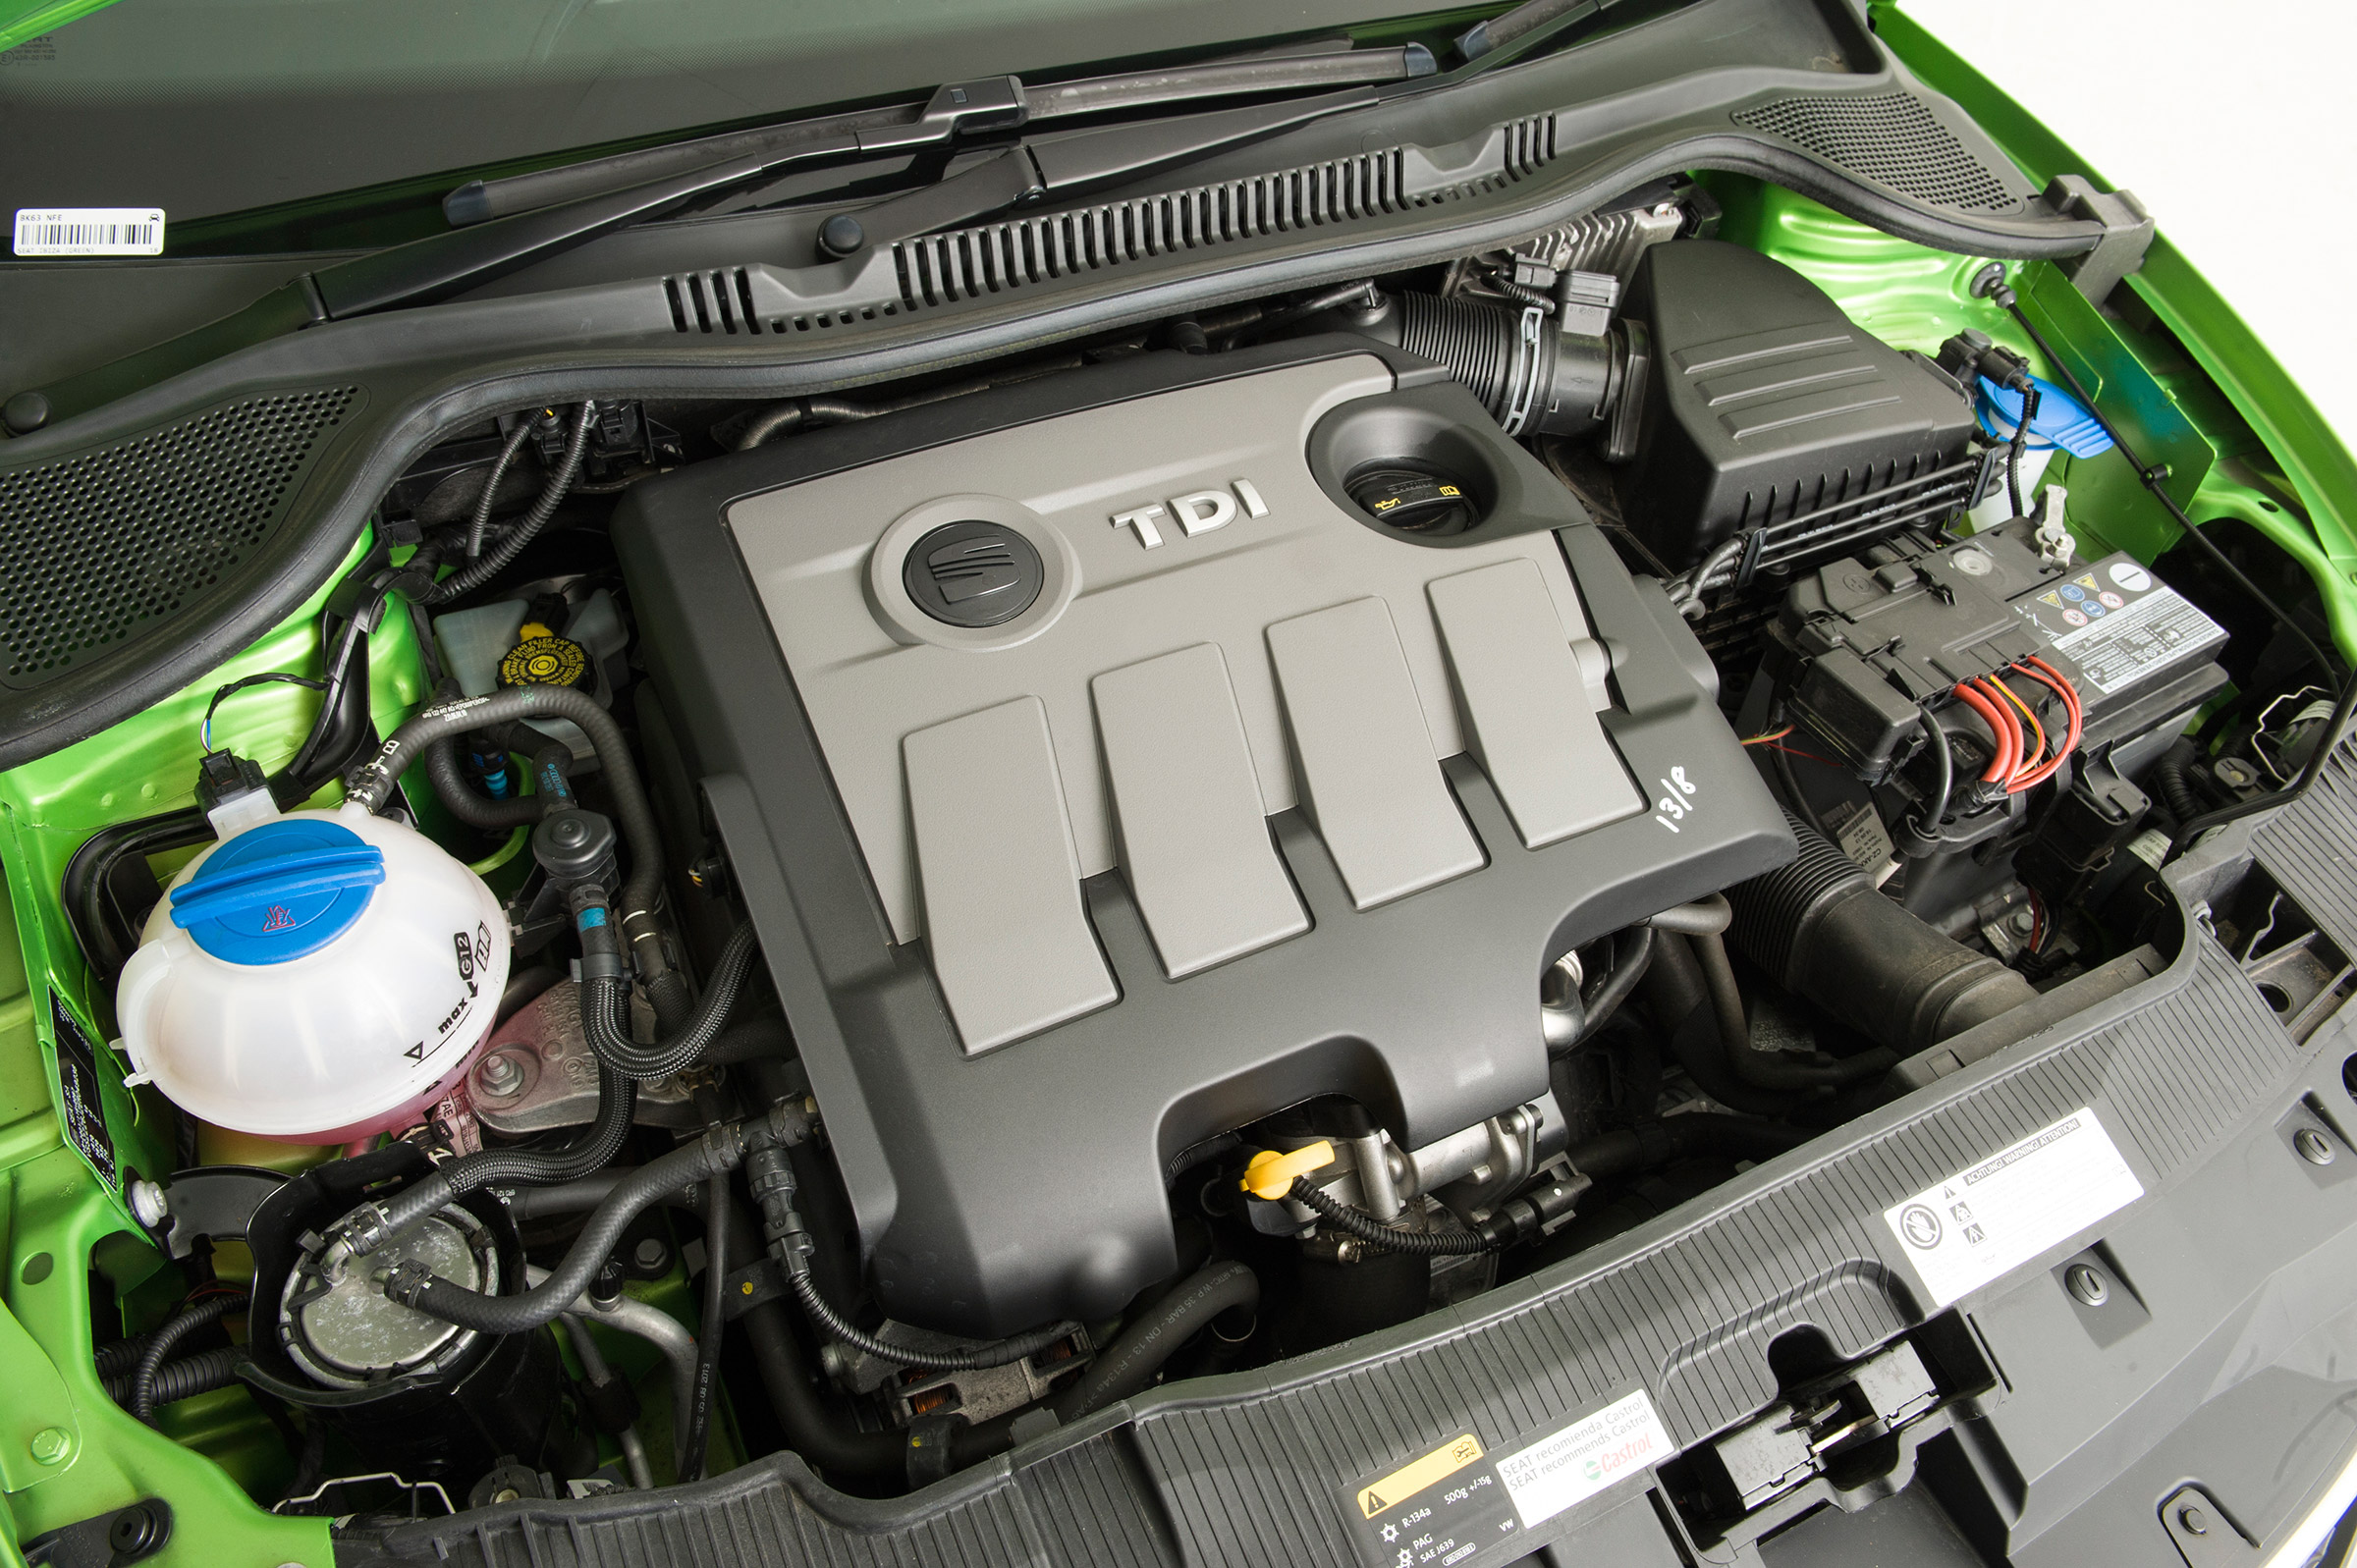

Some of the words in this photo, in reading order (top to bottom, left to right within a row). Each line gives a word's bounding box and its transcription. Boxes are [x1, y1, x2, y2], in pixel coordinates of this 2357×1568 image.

[1110, 477, 1271, 550] TDI
[508, 644, 527, 659] CLEAN
[1656, 766, 1696, 833] 13/8
[458, 937, 472, 974] G12
[438, 998, 467, 1034] max
[1966, 1158, 2005, 1185] ACHTUNG!
[2002, 1139, 2041, 1165] WARNING!
[2038, 1118, 2080, 1147] ATTENTION!
[1164, 1304, 1186, 1325] BAR
[1182, 1295, 1197, 1309] 35
[1130, 1340, 1147, 1356] 13
[1143, 1325, 1162, 1343] DN
[698, 1363, 710, 1413] 05.08.2013
[1502, 1454, 1535, 1479] SEAT
[1533, 1418, 1604, 1463] recomienda
[1603, 1396, 1645, 1427] Castrol
[1508, 1468, 1540, 1491] SEAT
[1539, 1430, 1612, 1476] recommends
[1610, 1409, 1651, 1438] Castrol
[1598, 1432, 1656, 1474] Castrol
[1400, 1505, 1433, 1529] R-134a
[1443, 1486, 1469, 1507] 500g
[1467, 1473, 1493, 1493] +/-15g
[1412, 1533, 1434, 1550] PAG
[1499, 1518, 1515, 1533] VW
[1419, 1548, 1437, 1564] SAE
[1435, 1538, 1456, 1555] J639
